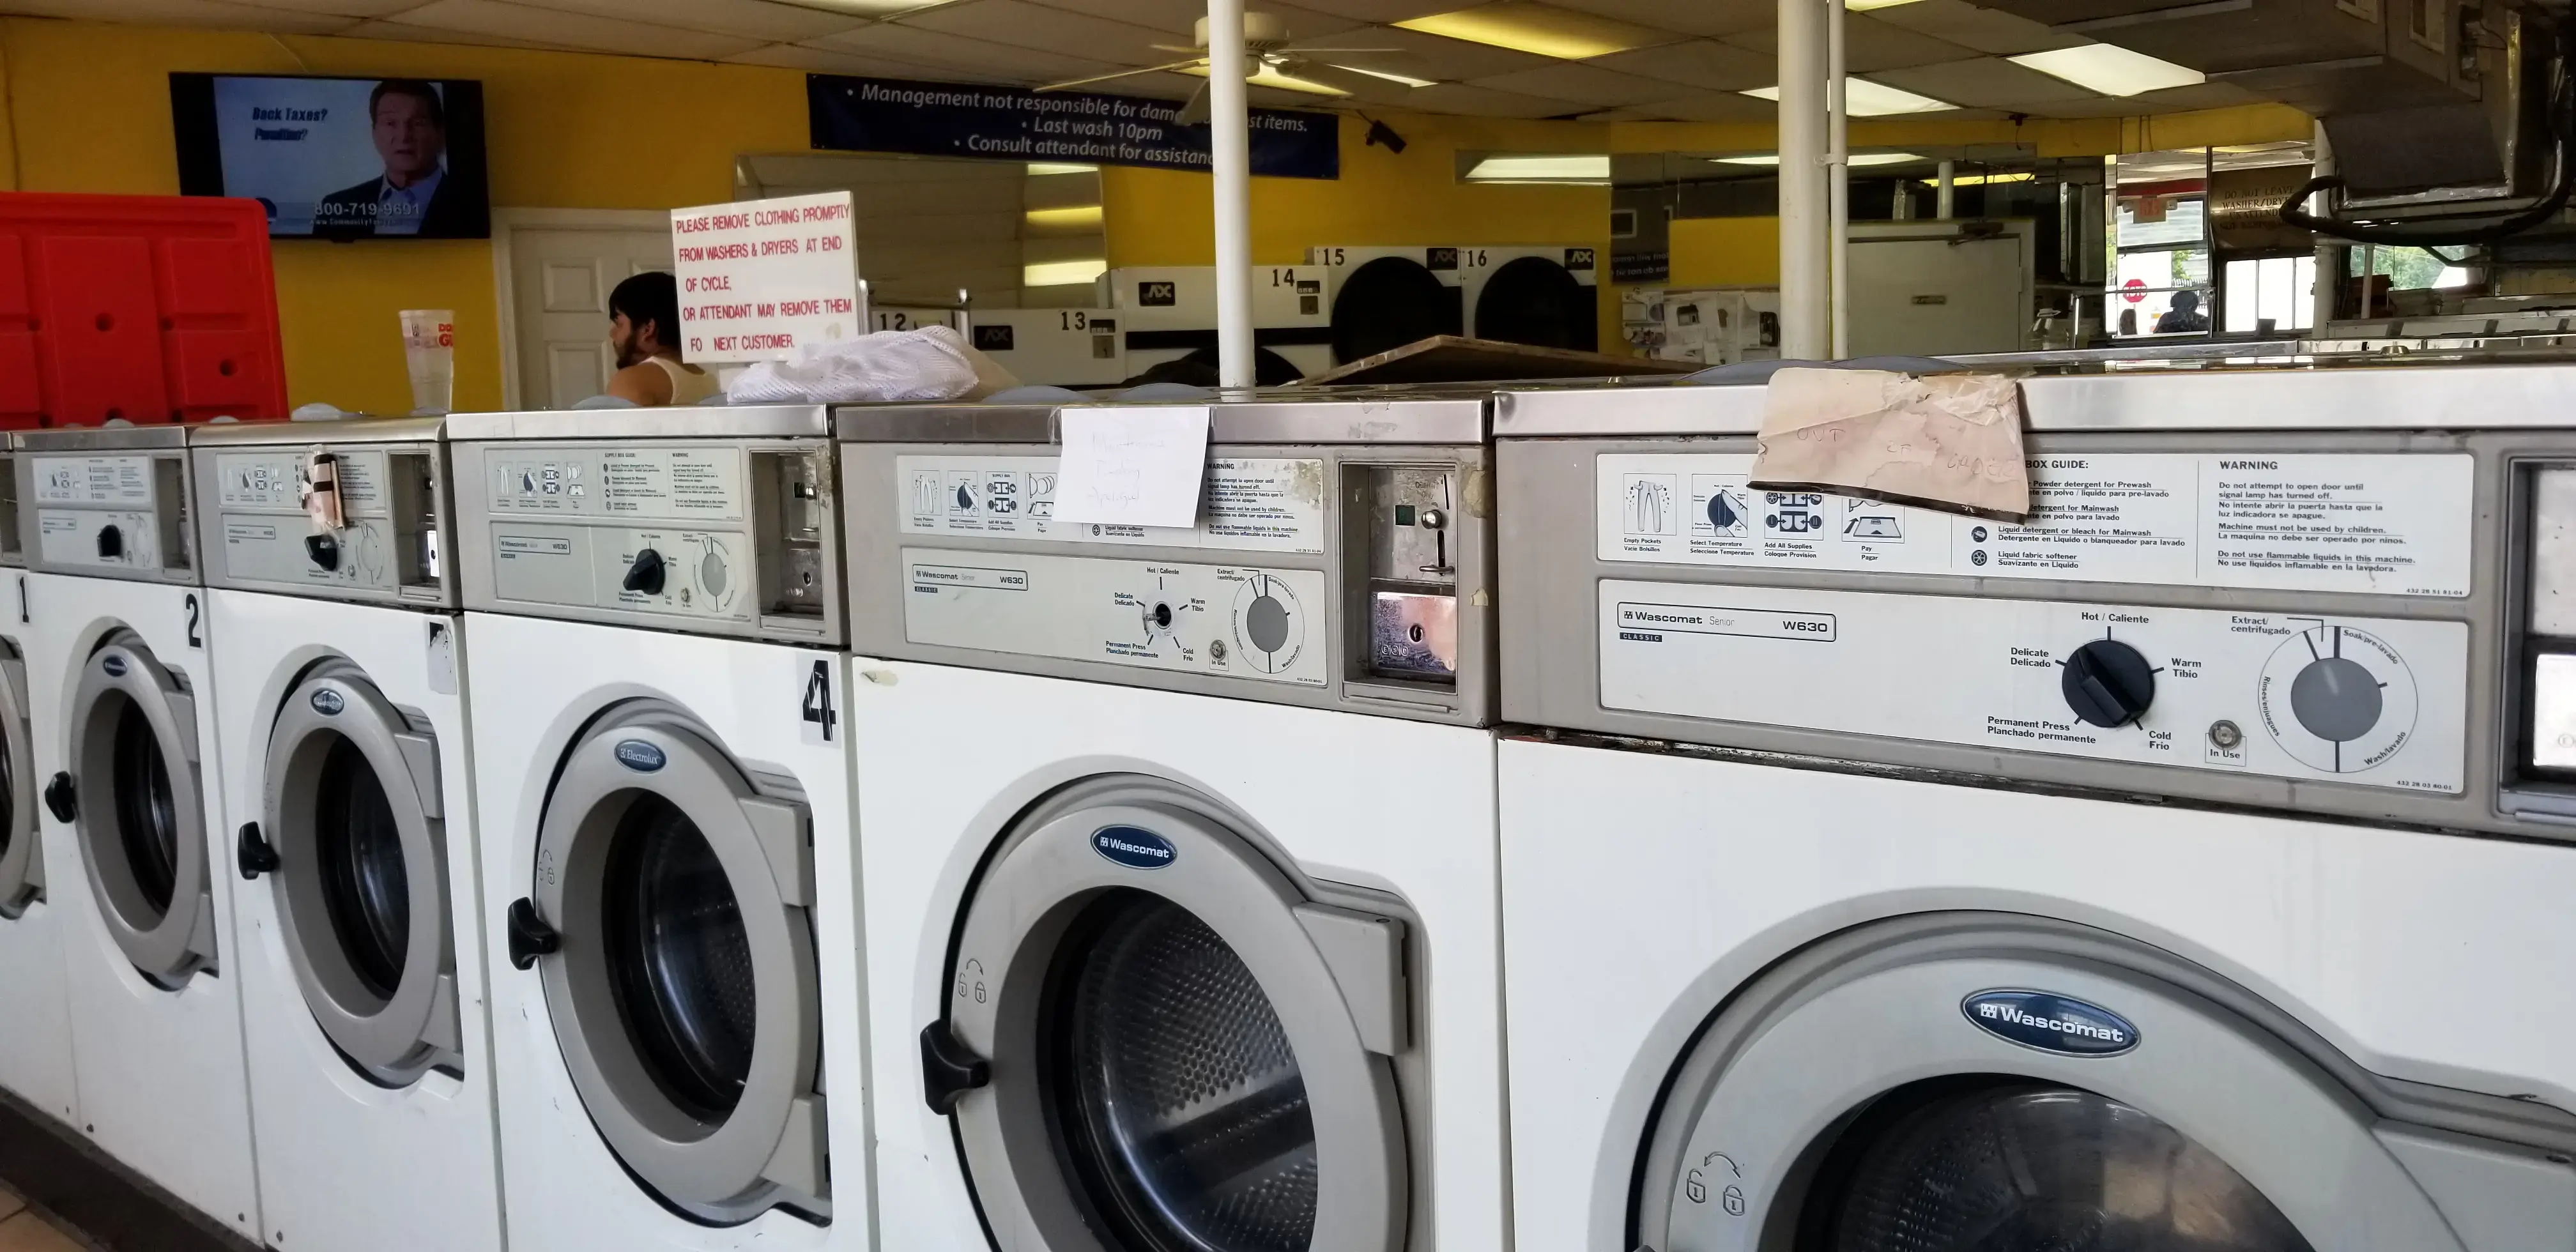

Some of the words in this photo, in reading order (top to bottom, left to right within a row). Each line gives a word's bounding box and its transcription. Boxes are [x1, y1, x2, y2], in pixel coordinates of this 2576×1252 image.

[286, 107, 328, 121] Taxes?
[862, 83, 980, 108] Management
[984, 95, 1014, 109] not
[1016, 96, 1108, 116] responsible
[1112, 100, 1136, 118] for
[1265, 114, 1308, 132] items.
[1034, 117, 1068, 134] Last
[1072, 120, 1113, 138] wash
[1117, 122, 1163, 143] 10pm
[968, 133, 1032, 154] Consult
[1036, 139, 1117, 158] attendant
[1119, 143, 1142, 160] for
[1145, 146, 1213, 166] assistanc
[677, 217, 710, 234] PLEASE
[713, 213, 749, 230] REMOVE
[755, 209, 799, 226] CLOTHING
[803, 203, 850, 222] PROMPTLY
[680, 247, 703, 263] FROM
[706, 243, 748, 261] WASHERS
[751, 244, 757, 256] &
[762, 240, 799, 256] DRYERS
[806, 238, 817, 253] AT
[822, 236, 841, 252] END
[1323, 248, 1345, 266] 15
[1468, 250, 1487, 267] 16
[686, 279, 697, 293] OF
[702, 276, 732, 291] CYCLE,
[1272, 268, 1294, 287] 14
[683, 307, 696, 321] OR
[700, 304, 752, 321] ATTENDANT
[758, 304, 776, 318] MAY
[781, 300, 820, 317] REMOVE
[824, 299, 852, 314] THEM
[880, 312, 907, 332] 12
[1061, 311, 1085, 332] 13
[714, 337, 737, 351] NEXT
[742, 334, 795, 350] CUSTOMER.
[2026, 461, 2048, 469] BOX
[2051, 461, 2089, 469] GUIDE:
[2220, 461, 2278, 470] WARNING
[2090, 537, 2138, 546] blanqueador
[2160, 538, 2185, 547] lavado
[922, 571, 958, 580] Wascomat
[1000, 576, 1023, 584] W630
[20, 576, 29, 623] 1
[186, 593, 201, 648] 2
[1635, 611, 1703, 625] Wascomat
[1710, 616, 1735, 627] Senior
[1783, 621, 1828, 632] W630
[2082, 612, 2099, 621] Hot
[2108, 613, 2149, 623] Caliente
[2232, 616, 2269, 625] Extract/
[2231, 625, 2291, 636] centrifugado
[1131, 650, 1158, 659] permanente
[2011, 647, 2049, 657] Delicate
[2011, 657, 2051, 668] Delicado
[2172, 658, 2202, 668] Warm
[2173, 669, 2198, 678] Tibio
[802, 659, 836, 742] 4
[1988, 716, 2039, 728] Permanent
[2043, 721, 2070, 731] Press
[1988, 726, 2034, 738] Planchado
[2038, 732, 2096, 744] permanente
[2149, 730, 2171, 740] Cold
[2149, 741, 2170, 750] Frio
[2364, 731, 2406, 767] Wash/lavado
[627, 749, 657, 765] Electrolux
[2223, 750, 2241, 760] Use
[1110, 838, 1169, 858] Wascomat
[2000, 1006, 2124, 1044] Wascomat
